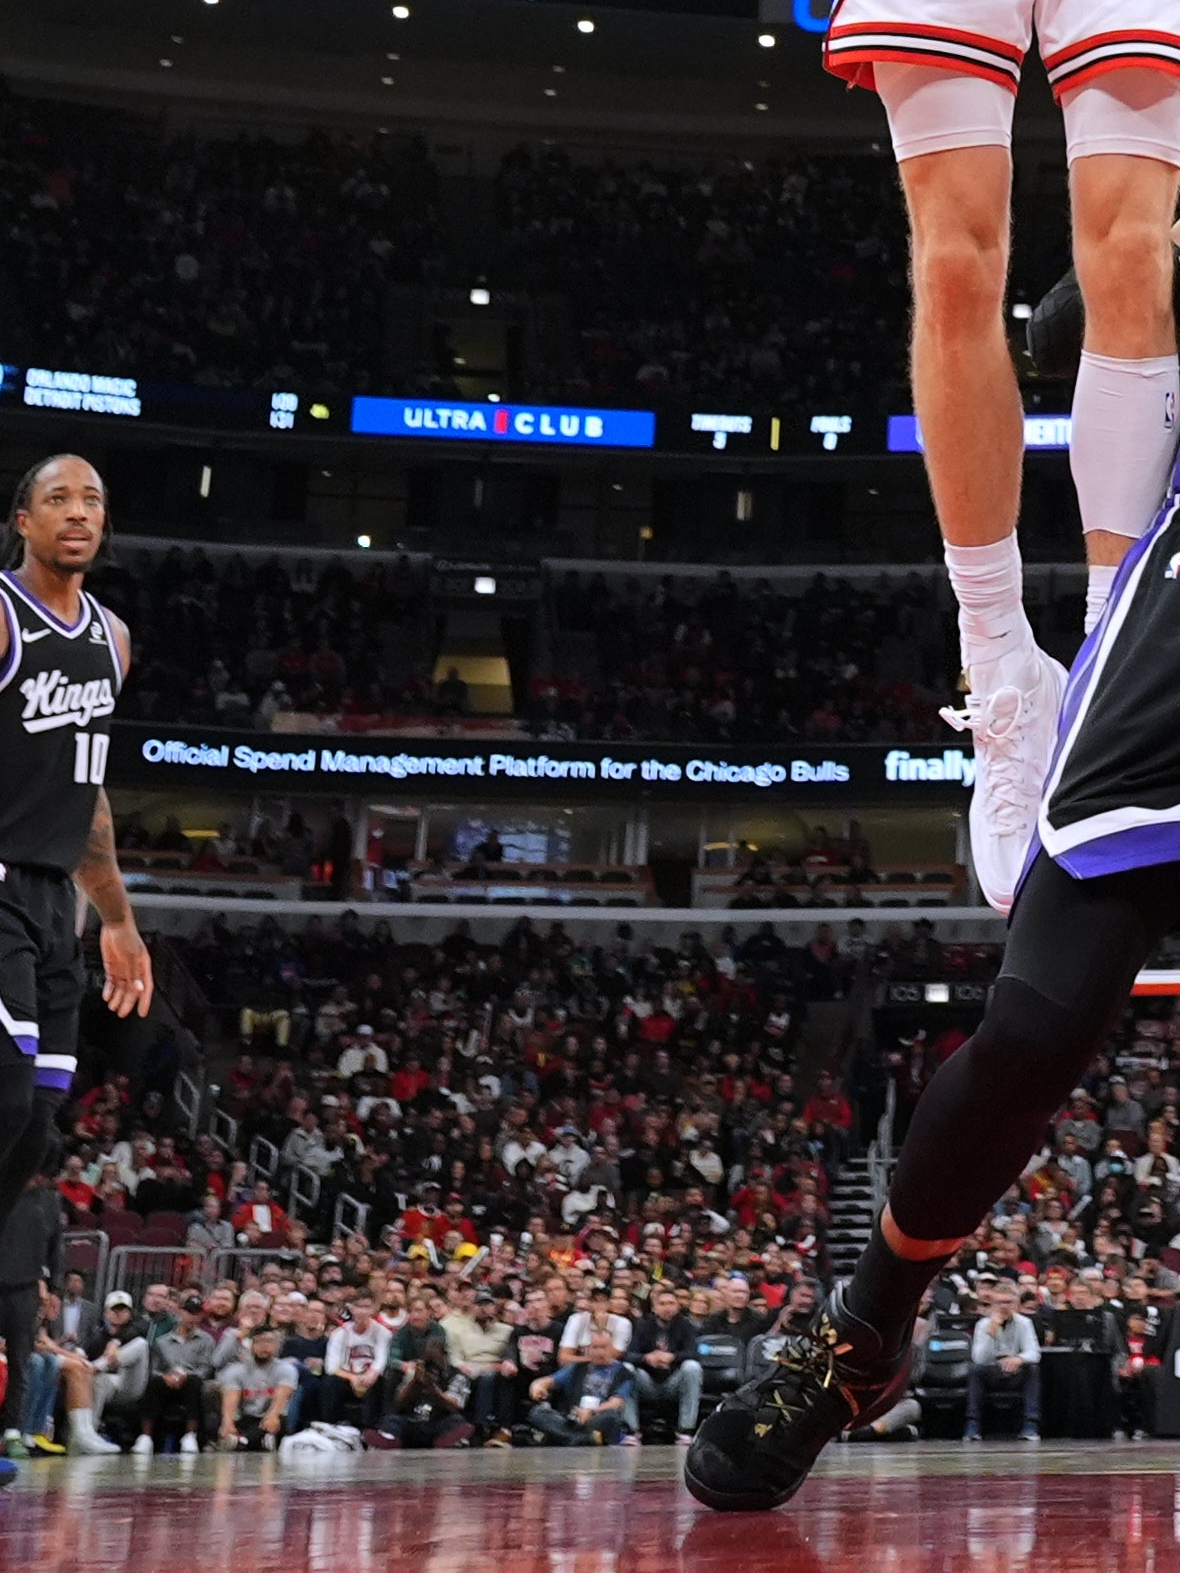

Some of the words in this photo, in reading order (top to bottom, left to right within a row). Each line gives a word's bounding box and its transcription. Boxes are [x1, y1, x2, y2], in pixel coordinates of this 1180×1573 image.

[26, 368, 91, 393] ORLANDO
[23, 385, 83, 411] DETROIT
[82, 393, 142, 417] PISTONS
[404, 407, 486, 431] ULTRA
[515, 412, 604, 438] CLUB
[19, 670, 115, 734] Kings
[74, 732, 110, 785] 10
[142, 739, 229, 766] Official
[233, 746, 316, 773] Spend
[320, 750, 485, 778] Management
[489, 754, 595, 778] Platform
[600, 758, 637, 779] for
[641, 760, 682, 781] the
[686, 760, 786, 786] Chicago
[791, 760, 849, 782] Bulls
[884, 750, 977, 787] finally
